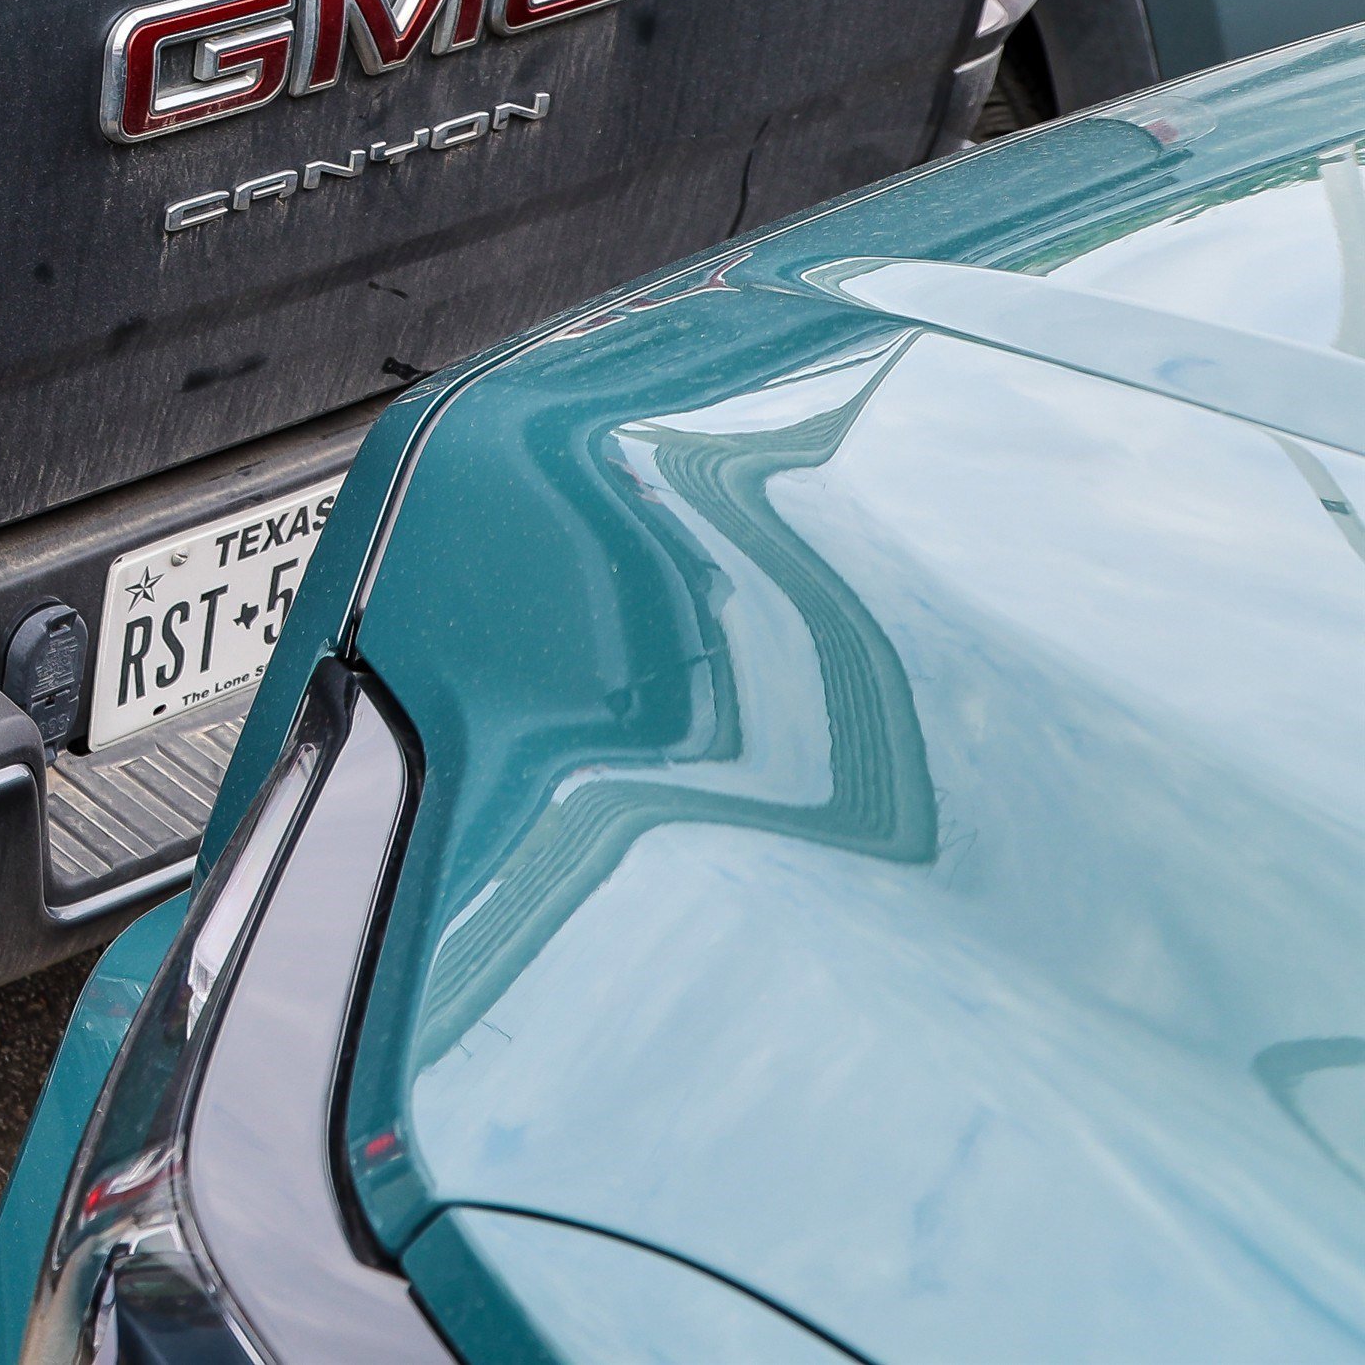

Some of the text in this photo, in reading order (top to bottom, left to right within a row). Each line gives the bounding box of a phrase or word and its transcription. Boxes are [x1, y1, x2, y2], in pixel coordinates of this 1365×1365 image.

[165, 91, 551, 233] CANYON
[215, 495, 335, 569] TEXAS
[181, 689, 211, 707] The
[214, 672, 251, 694] Lone
